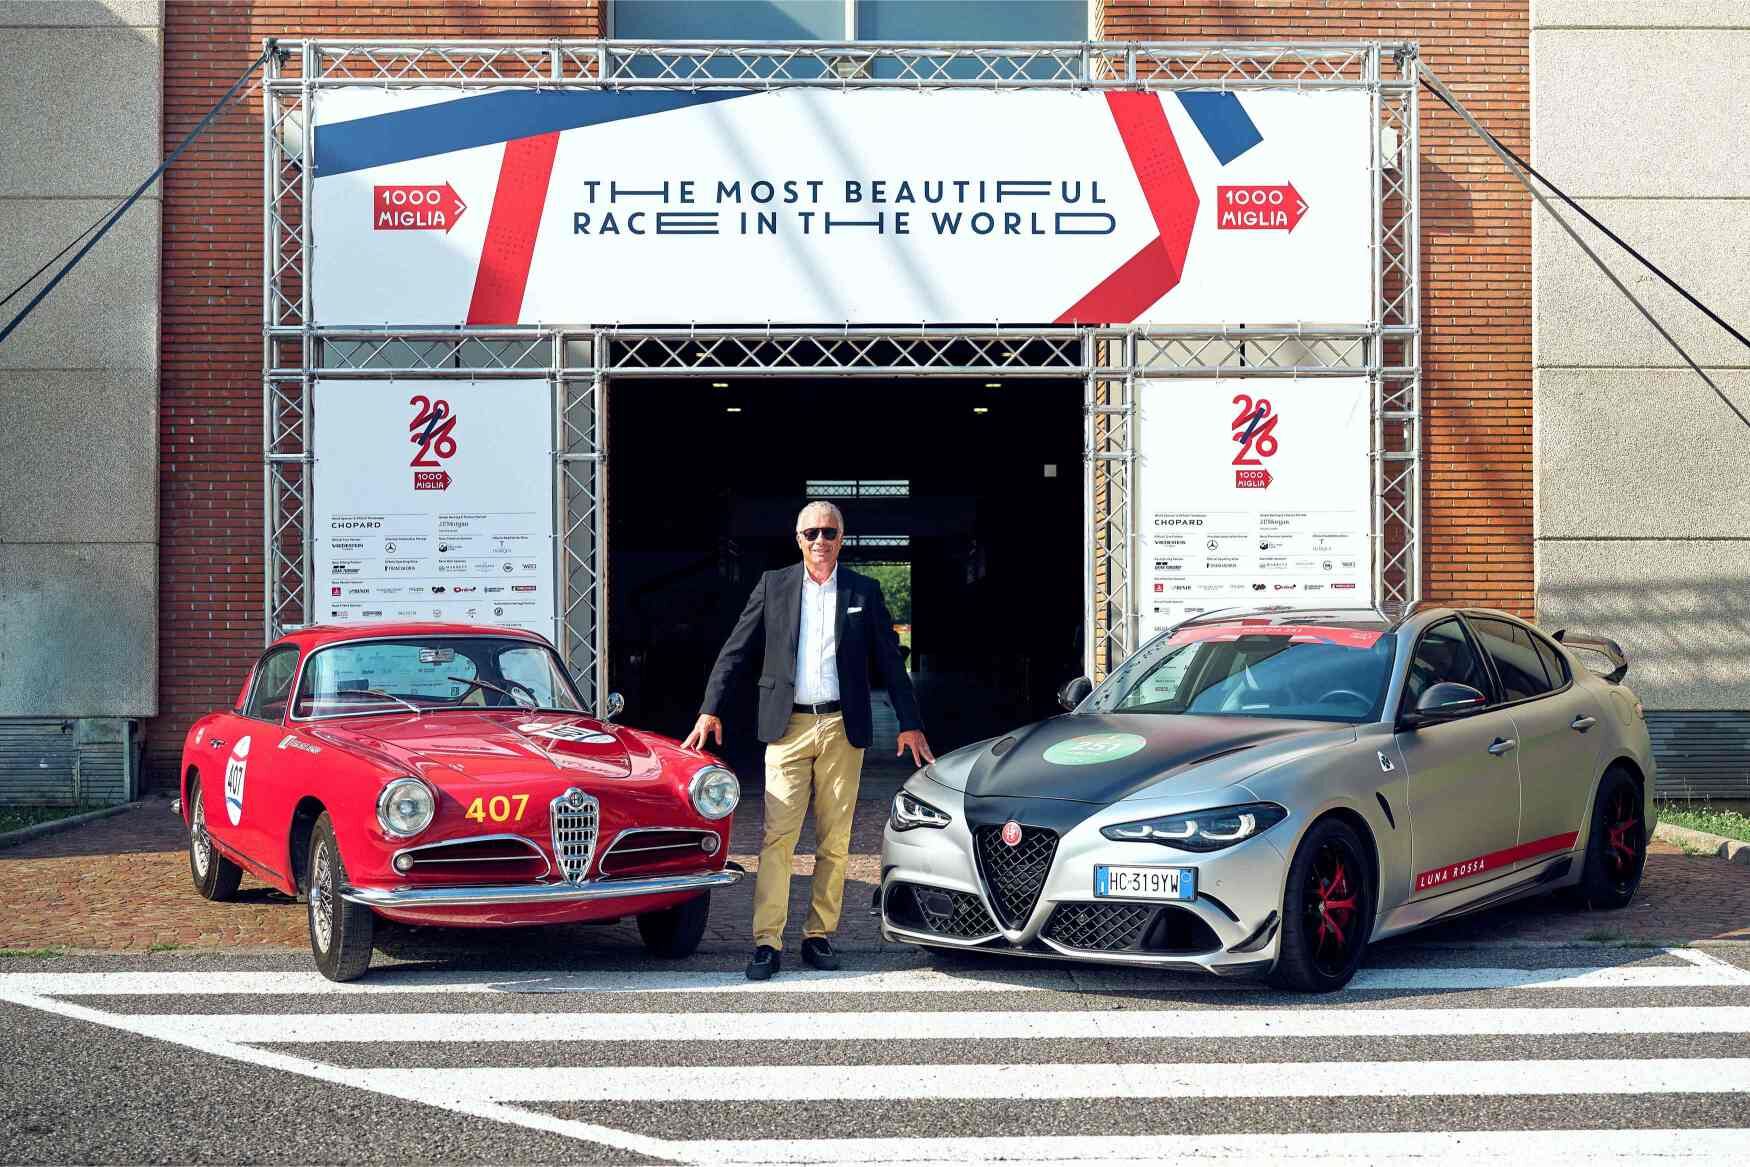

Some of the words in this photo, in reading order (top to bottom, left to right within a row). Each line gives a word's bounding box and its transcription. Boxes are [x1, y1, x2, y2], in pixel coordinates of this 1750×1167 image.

[382, 190, 441, 205] 1000
[583, 180, 695, 204] THE
[716, 180, 824, 204] MOST
[845, 180, 1106, 204] BEAUTIFUL
[1226, 190, 1284, 205] 1000
[378, 211, 446, 226] MIGLIA
[573, 211, 720, 235] RACE
[741, 211, 777, 235] IN
[798, 211, 910, 235] THE
[931, 211, 1117, 235] WORLD
[1222, 211, 1288, 226] MIGLIA
[1239, 471, 1264, 479] 1000
[416, 481, 444, 489] MIGLIA
[1238, 480, 1265, 488] MIGLIA
[331, 521, 381, 529] CHOPARD
[227, 764, 244, 796] 407
[464, 793, 530, 824] 407
[1420, 871, 1448, 887] LUNA
[1453, 858, 1485, 878] ROSSA
